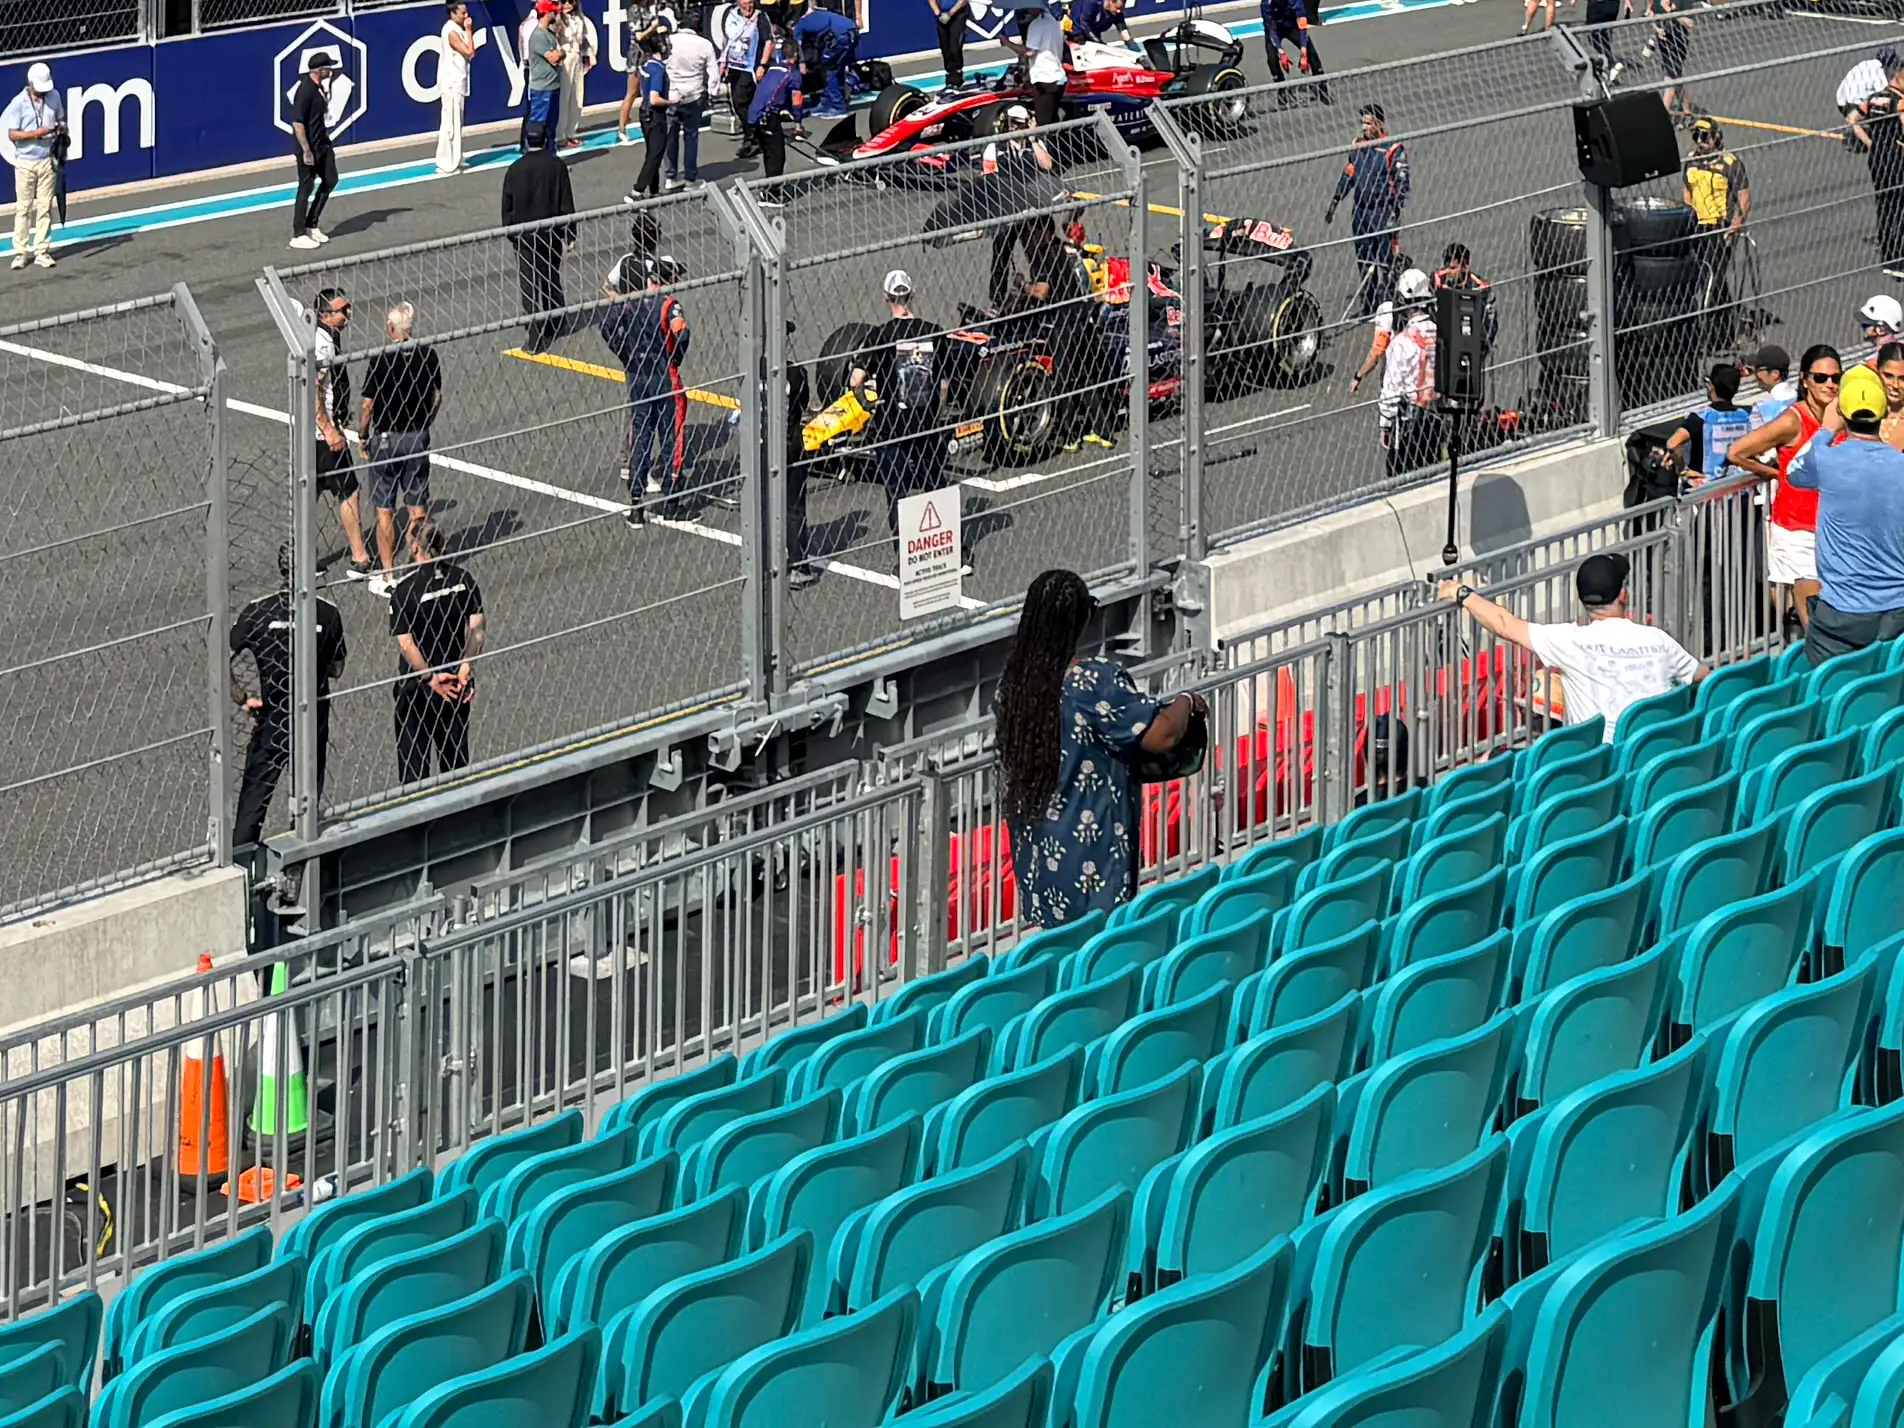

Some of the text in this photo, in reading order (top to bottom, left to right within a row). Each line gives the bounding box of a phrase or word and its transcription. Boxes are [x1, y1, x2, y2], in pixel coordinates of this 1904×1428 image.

[908, 530, 954, 554] DANGER
[908, 545, 954, 566] DO NOT ENTER
